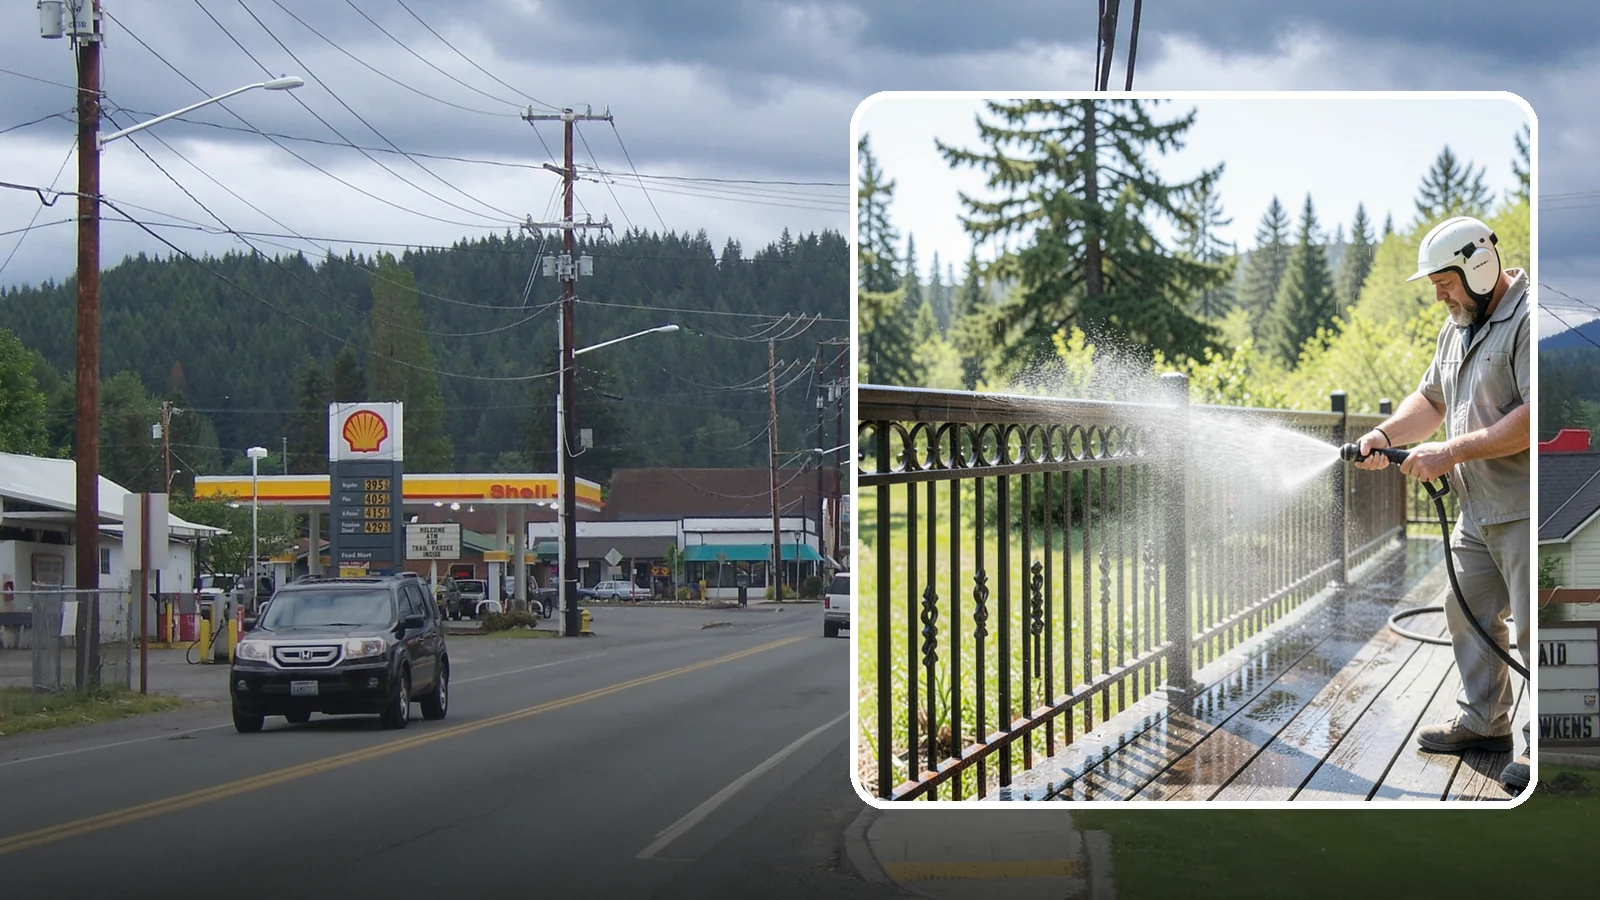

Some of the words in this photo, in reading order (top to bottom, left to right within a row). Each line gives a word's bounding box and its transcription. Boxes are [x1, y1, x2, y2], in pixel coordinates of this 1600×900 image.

[366, 480, 383, 490] 395
[490, 484, 547, 499] Shell
[365, 494, 383, 504] 405
[365, 508, 383, 518] 415
[365, 522, 383, 532] 429
